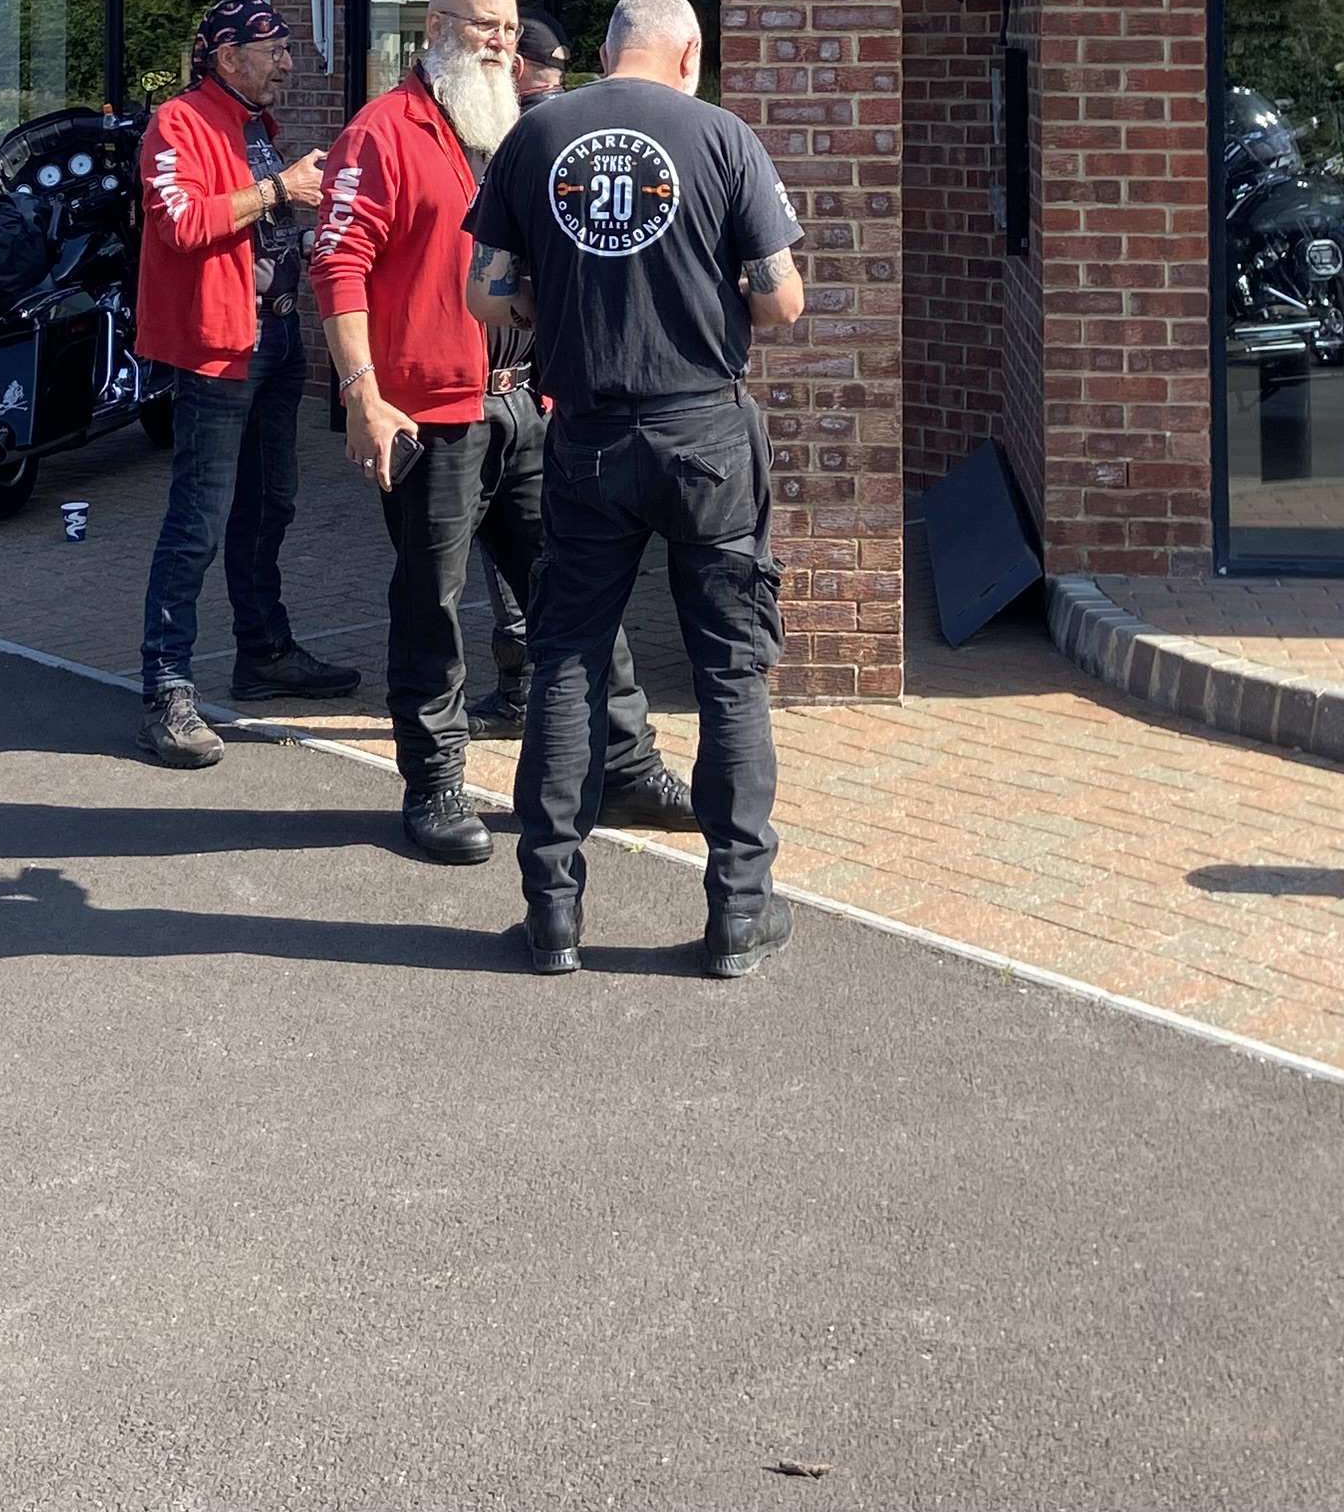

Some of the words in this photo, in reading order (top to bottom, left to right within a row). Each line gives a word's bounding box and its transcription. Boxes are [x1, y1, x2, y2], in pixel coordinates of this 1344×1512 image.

[574, 135, 656, 160] HARLEY
[593, 154, 632, 172] SYKES
[589, 174, 633, 221] 20
[567, 217, 660, 250] DAVIDSON
[594, 221, 629, 230] YEARS
